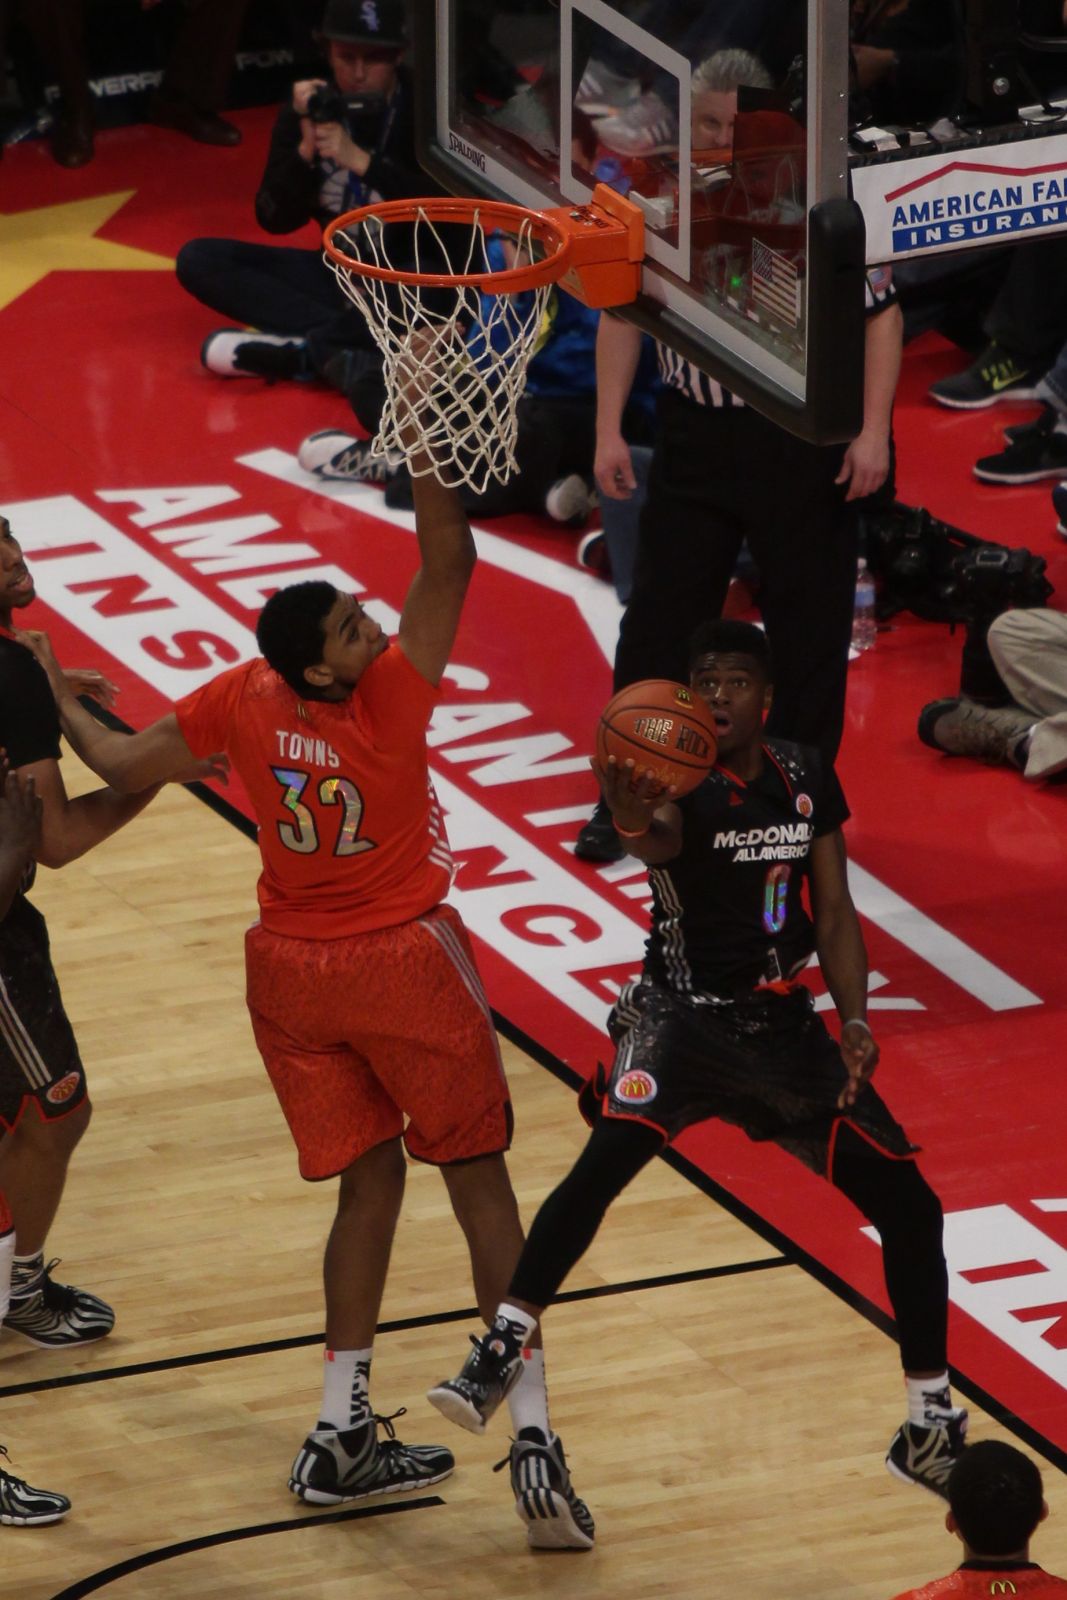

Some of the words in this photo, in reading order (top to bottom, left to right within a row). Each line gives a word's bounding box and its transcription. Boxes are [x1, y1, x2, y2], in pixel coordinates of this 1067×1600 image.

[449, 132, 488, 174] SPALDING
[892, 185, 1023, 228] AMERICAN
[1032, 177, 1067, 203] FA
[910, 206, 1067, 246] INSURAN
[275, 729, 341, 769] TOWNS
[634, 717, 674, 747] THE
[269, 764, 379, 857] 32
[713, 822, 815, 849] McDONAL
